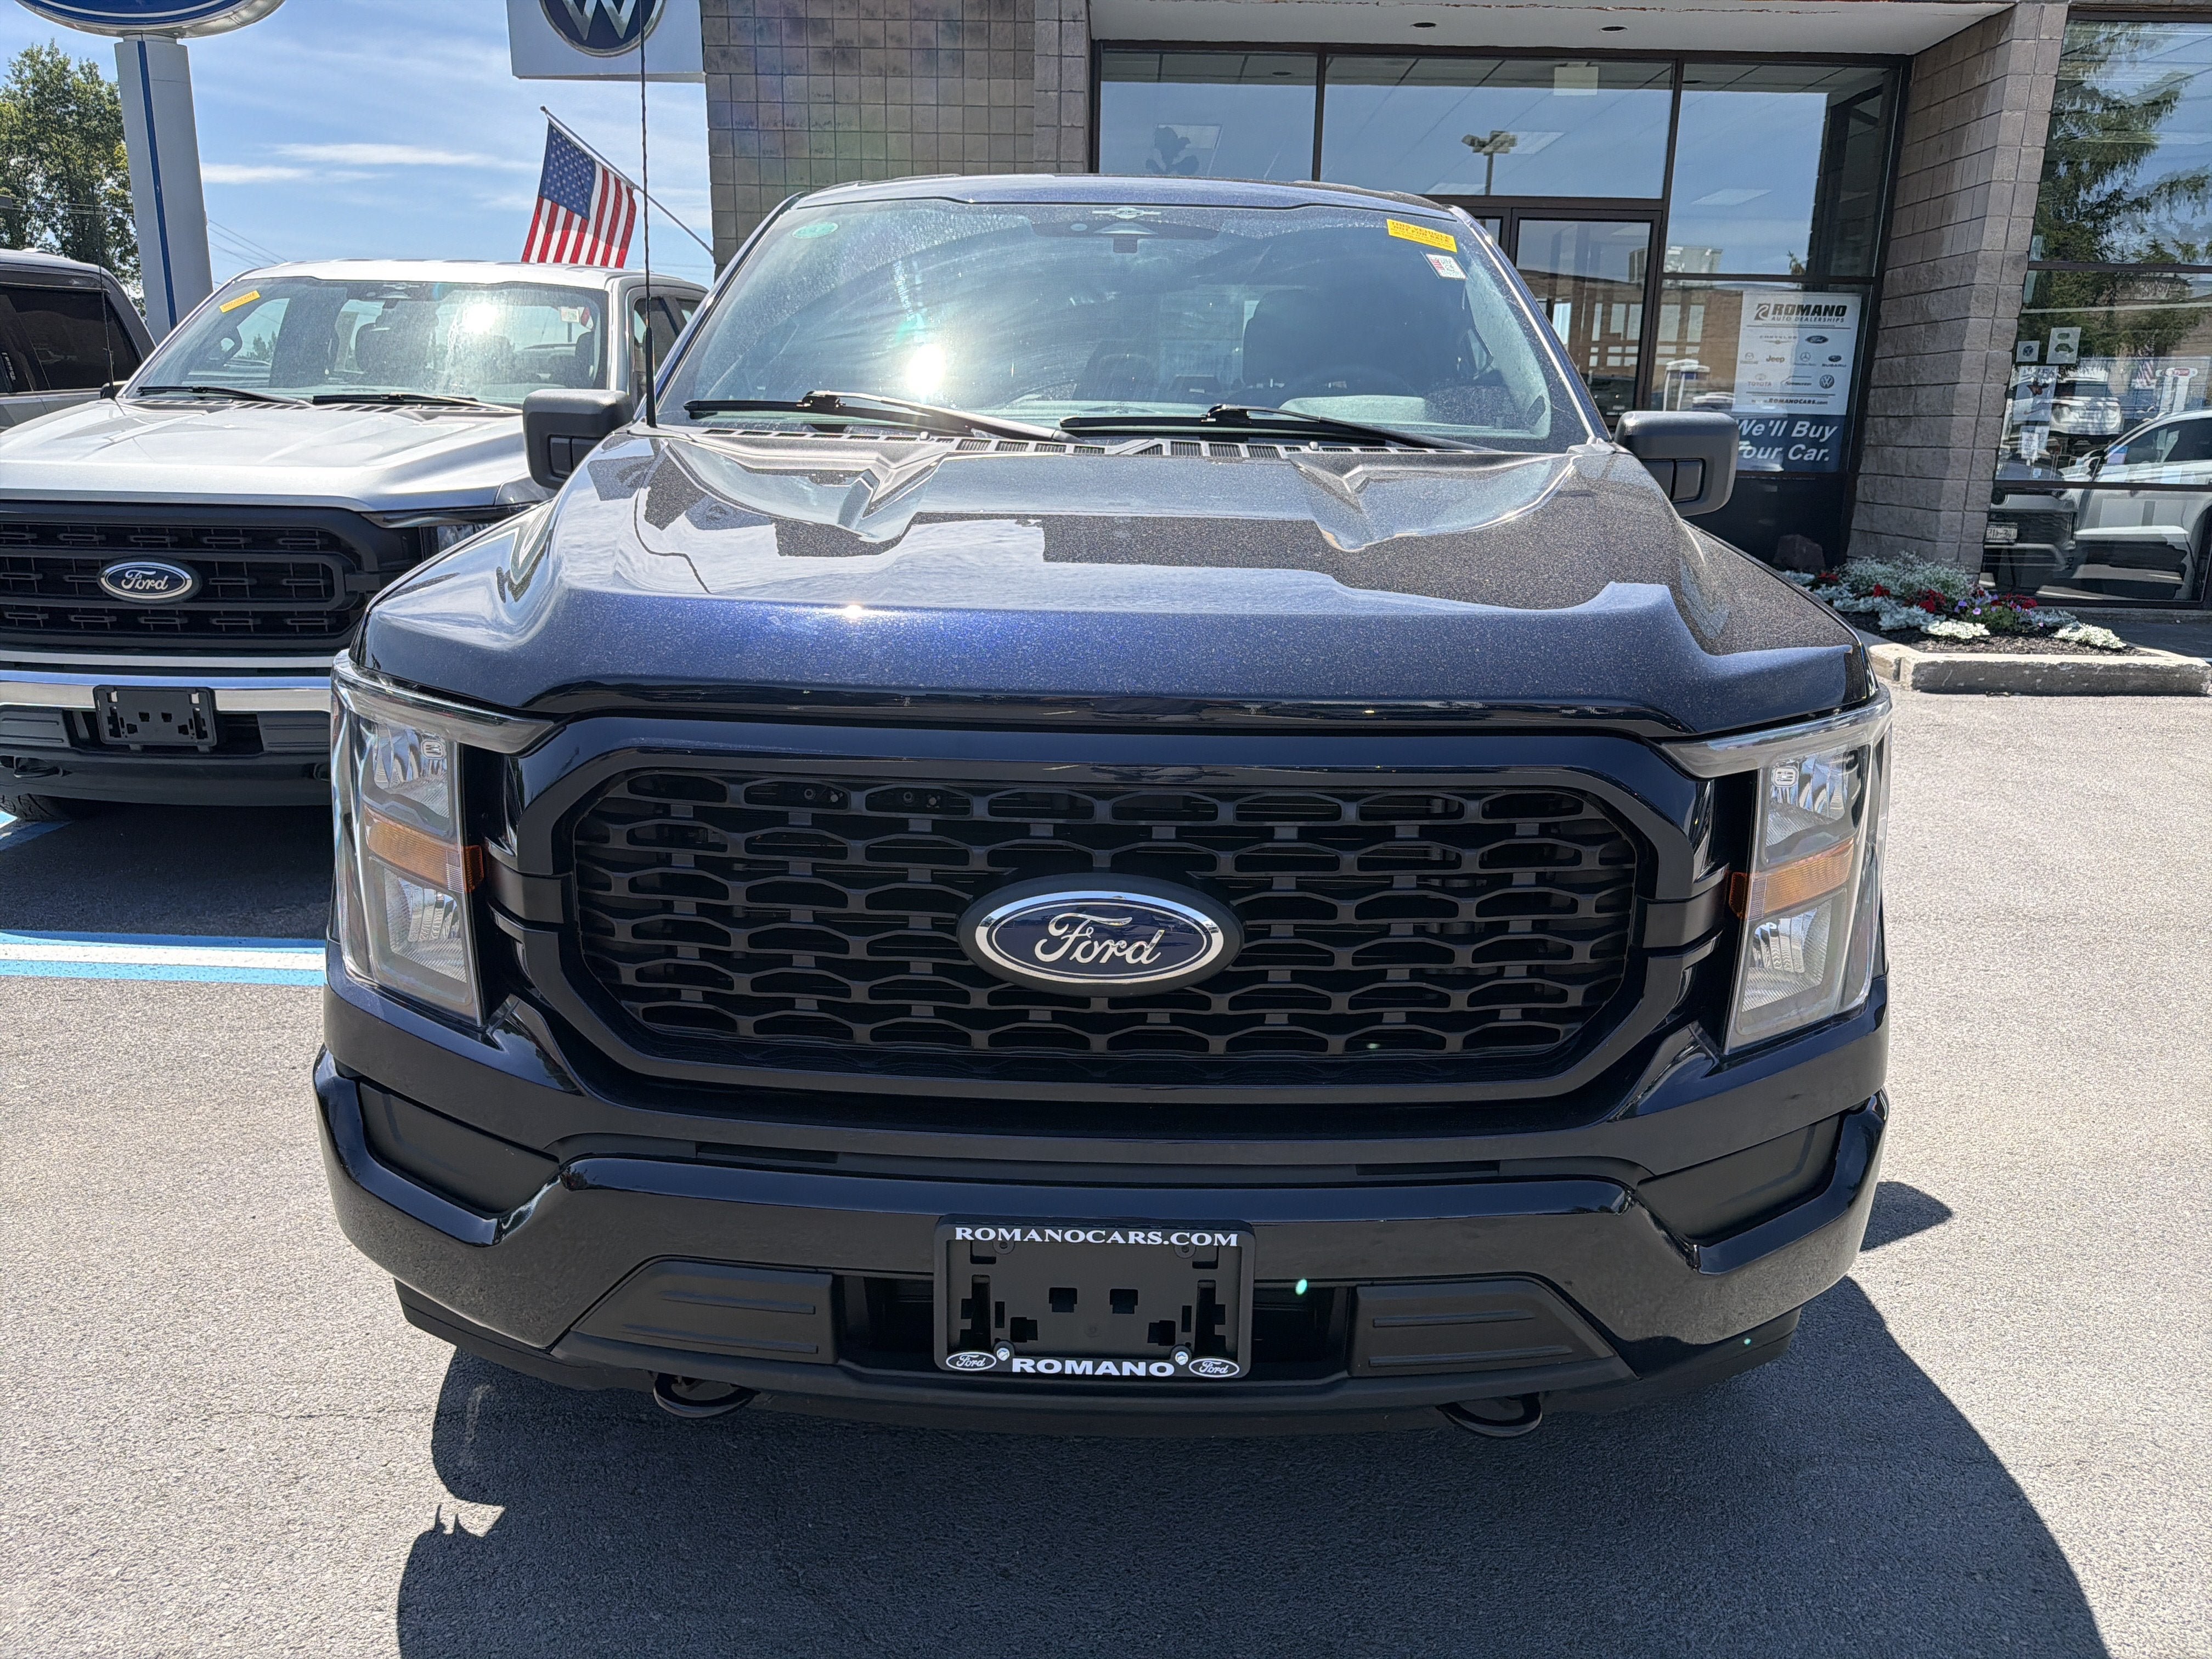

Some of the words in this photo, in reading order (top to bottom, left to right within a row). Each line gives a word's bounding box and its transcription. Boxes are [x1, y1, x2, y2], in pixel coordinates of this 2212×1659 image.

[1772, 303, 1847, 317] ROMANO
[1766, 354, 1785, 363] Jeep
[1738, 419, 1788, 437] We'll
[1791, 420, 1838, 443] Buy
[1787, 443, 1830, 462] Car.
[121, 569, 169, 591] Ford
[1034, 912, 1165, 964] Ford
[955, 1227, 1239, 1247] ROMANOCARS.COM
[956, 1354, 988, 1368] Ford
[1012, 1357, 1175, 1378] ROMANO
[1198, 1360, 1230, 1375] Ford
